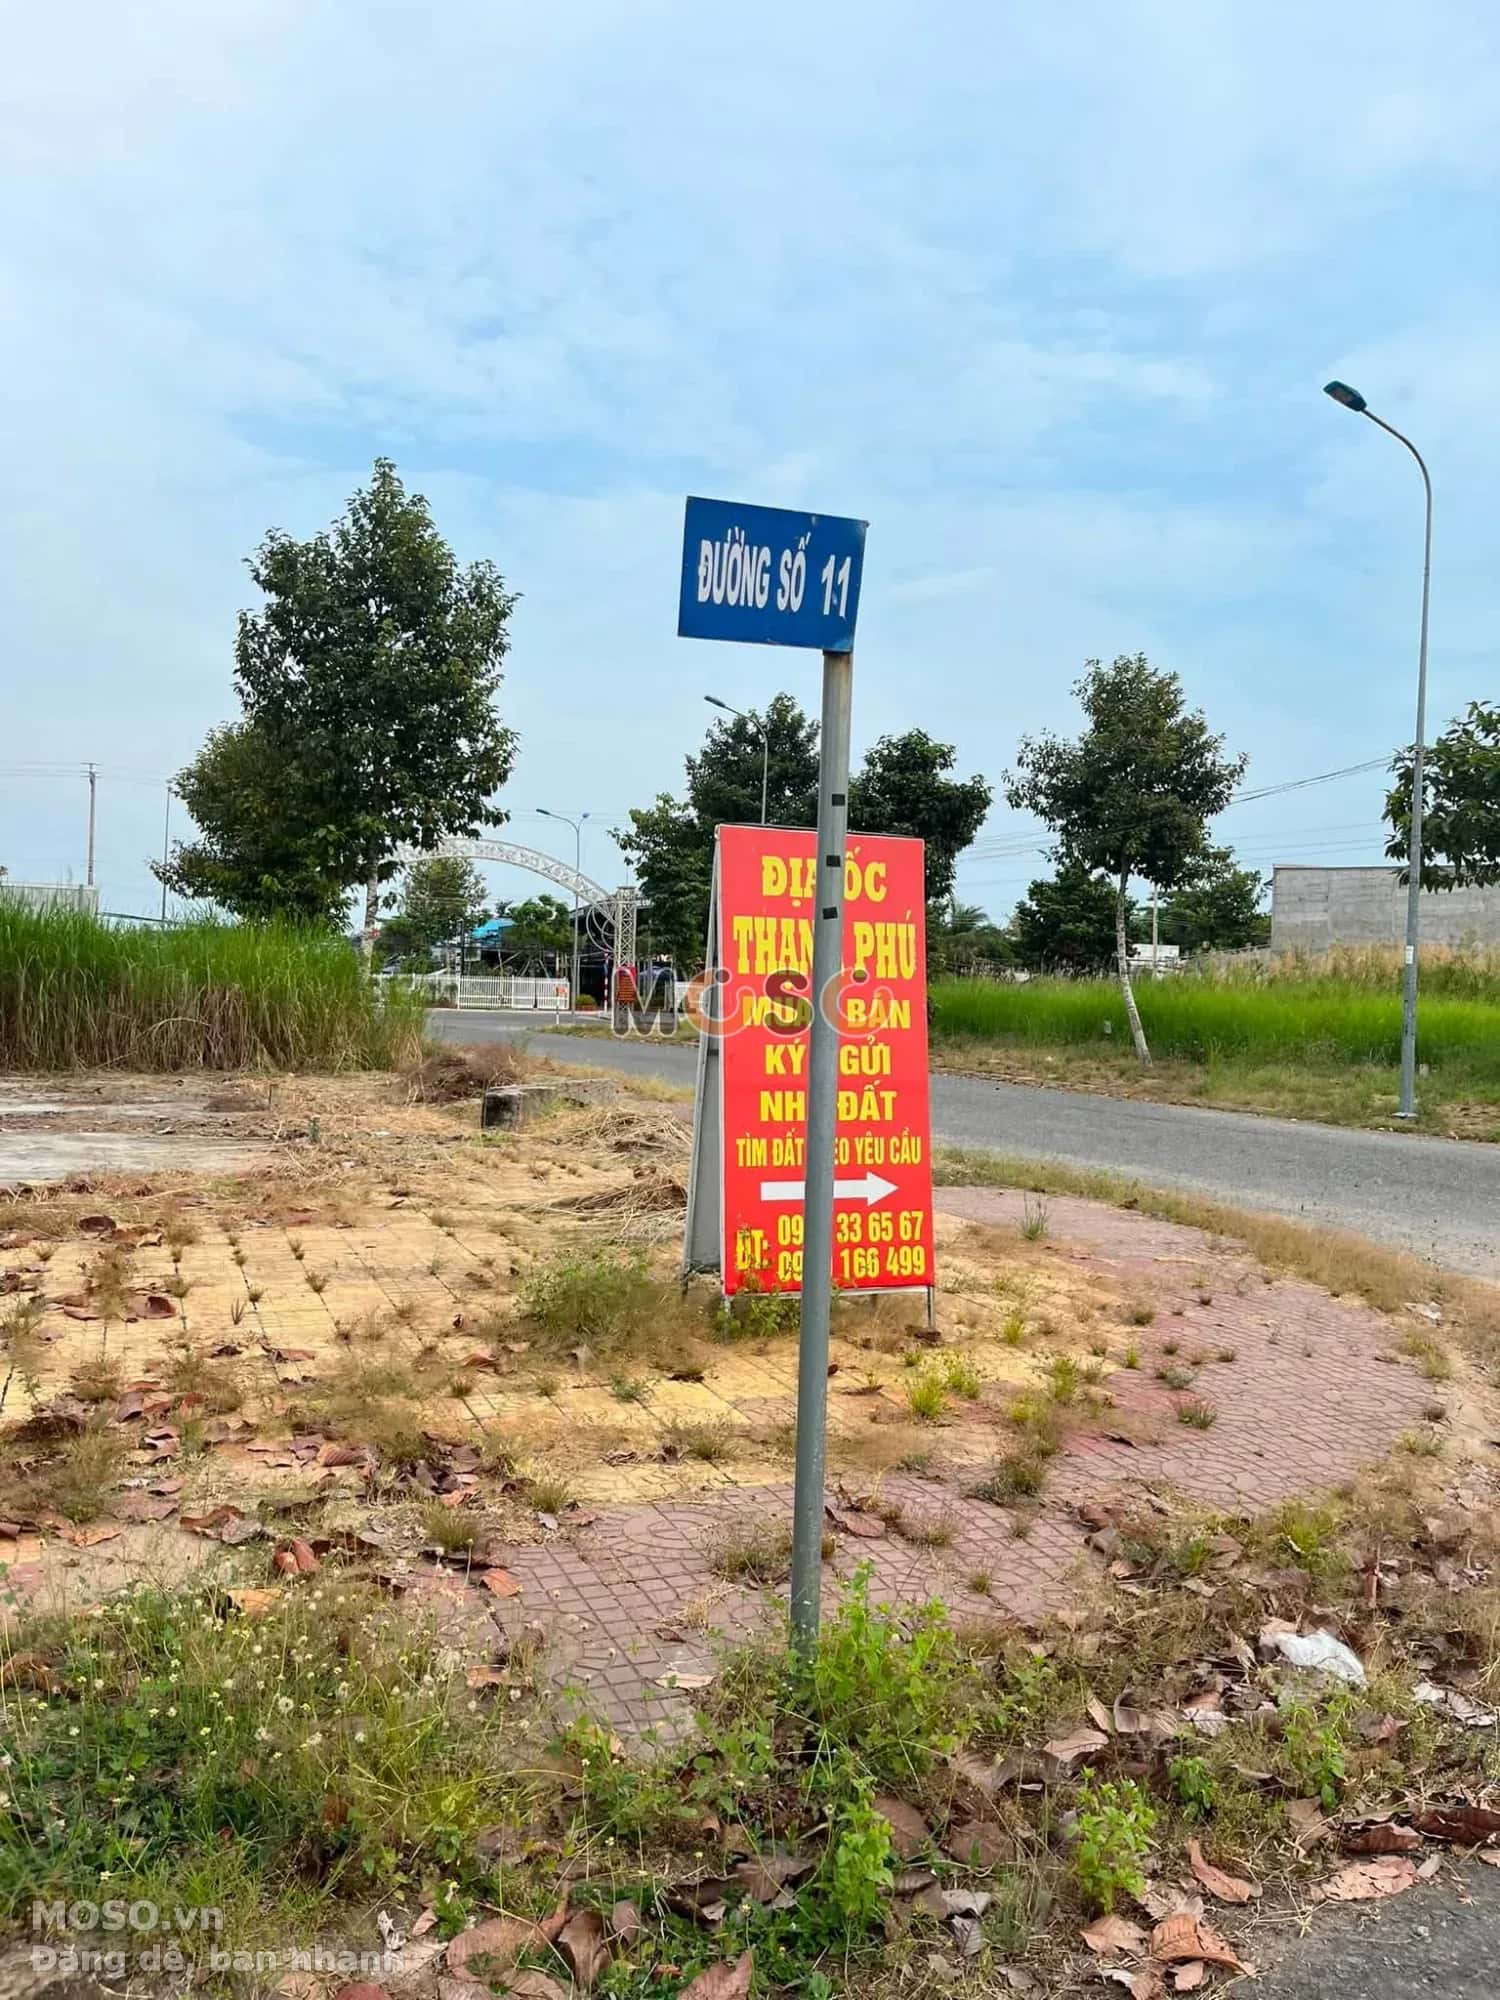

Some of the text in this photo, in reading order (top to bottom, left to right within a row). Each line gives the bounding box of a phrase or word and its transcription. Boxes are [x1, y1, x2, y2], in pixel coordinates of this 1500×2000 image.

[698, 526, 852, 618] ĐƯỜNG SỐ 11
[853, 909, 917, 981] PHÚ
[847, 991, 911, 1029] BÁN
[765, 1034, 892, 1075] KÝ GỬI
[760, 1079, 897, 1121] NH ĐẤT
[736, 1131, 768, 1167] TÌM
[772, 1127, 805, 1167] ĐẤT
[855, 1130, 884, 1165] YÊU
[890, 1126, 922, 1165] CẦU
[837, 1212, 862, 1243] 33
[868, 1211, 893, 1242] 65
[899, 1210, 924, 1241] 67
[839, 1247, 880, 1280] 166
[886, 1245, 926, 1276] 499
